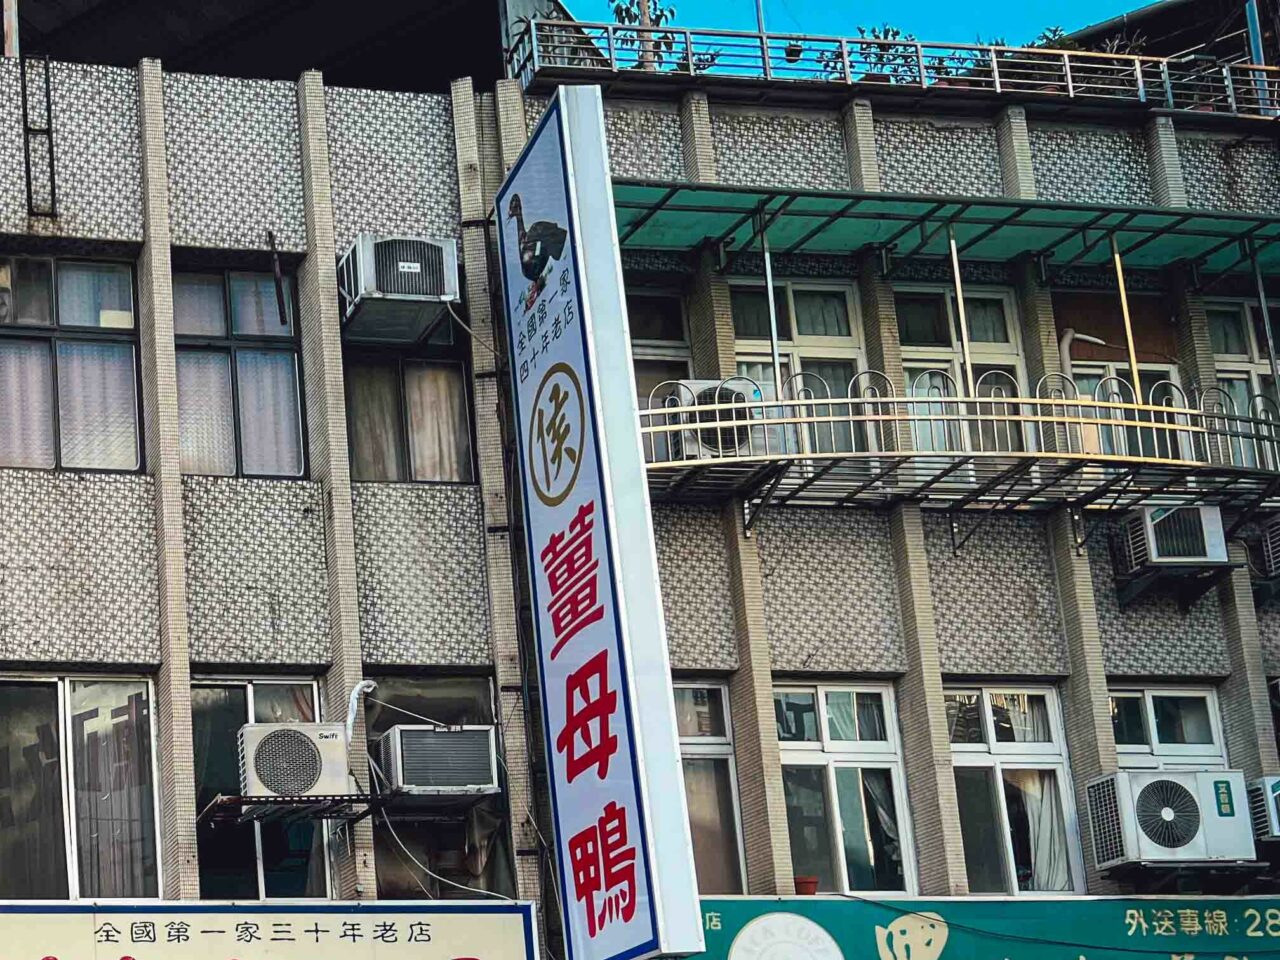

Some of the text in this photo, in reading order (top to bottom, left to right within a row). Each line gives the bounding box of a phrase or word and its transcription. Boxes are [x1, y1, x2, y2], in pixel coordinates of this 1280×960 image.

[516, 267, 572, 356] 全國第一家
[519, 300, 576, 384] 四十年老店
[537, 382, 577, 494] 侯
[539, 498, 637, 940] 薑母鴨
[93, 919, 434, 946] 全國第一家三十年老店
